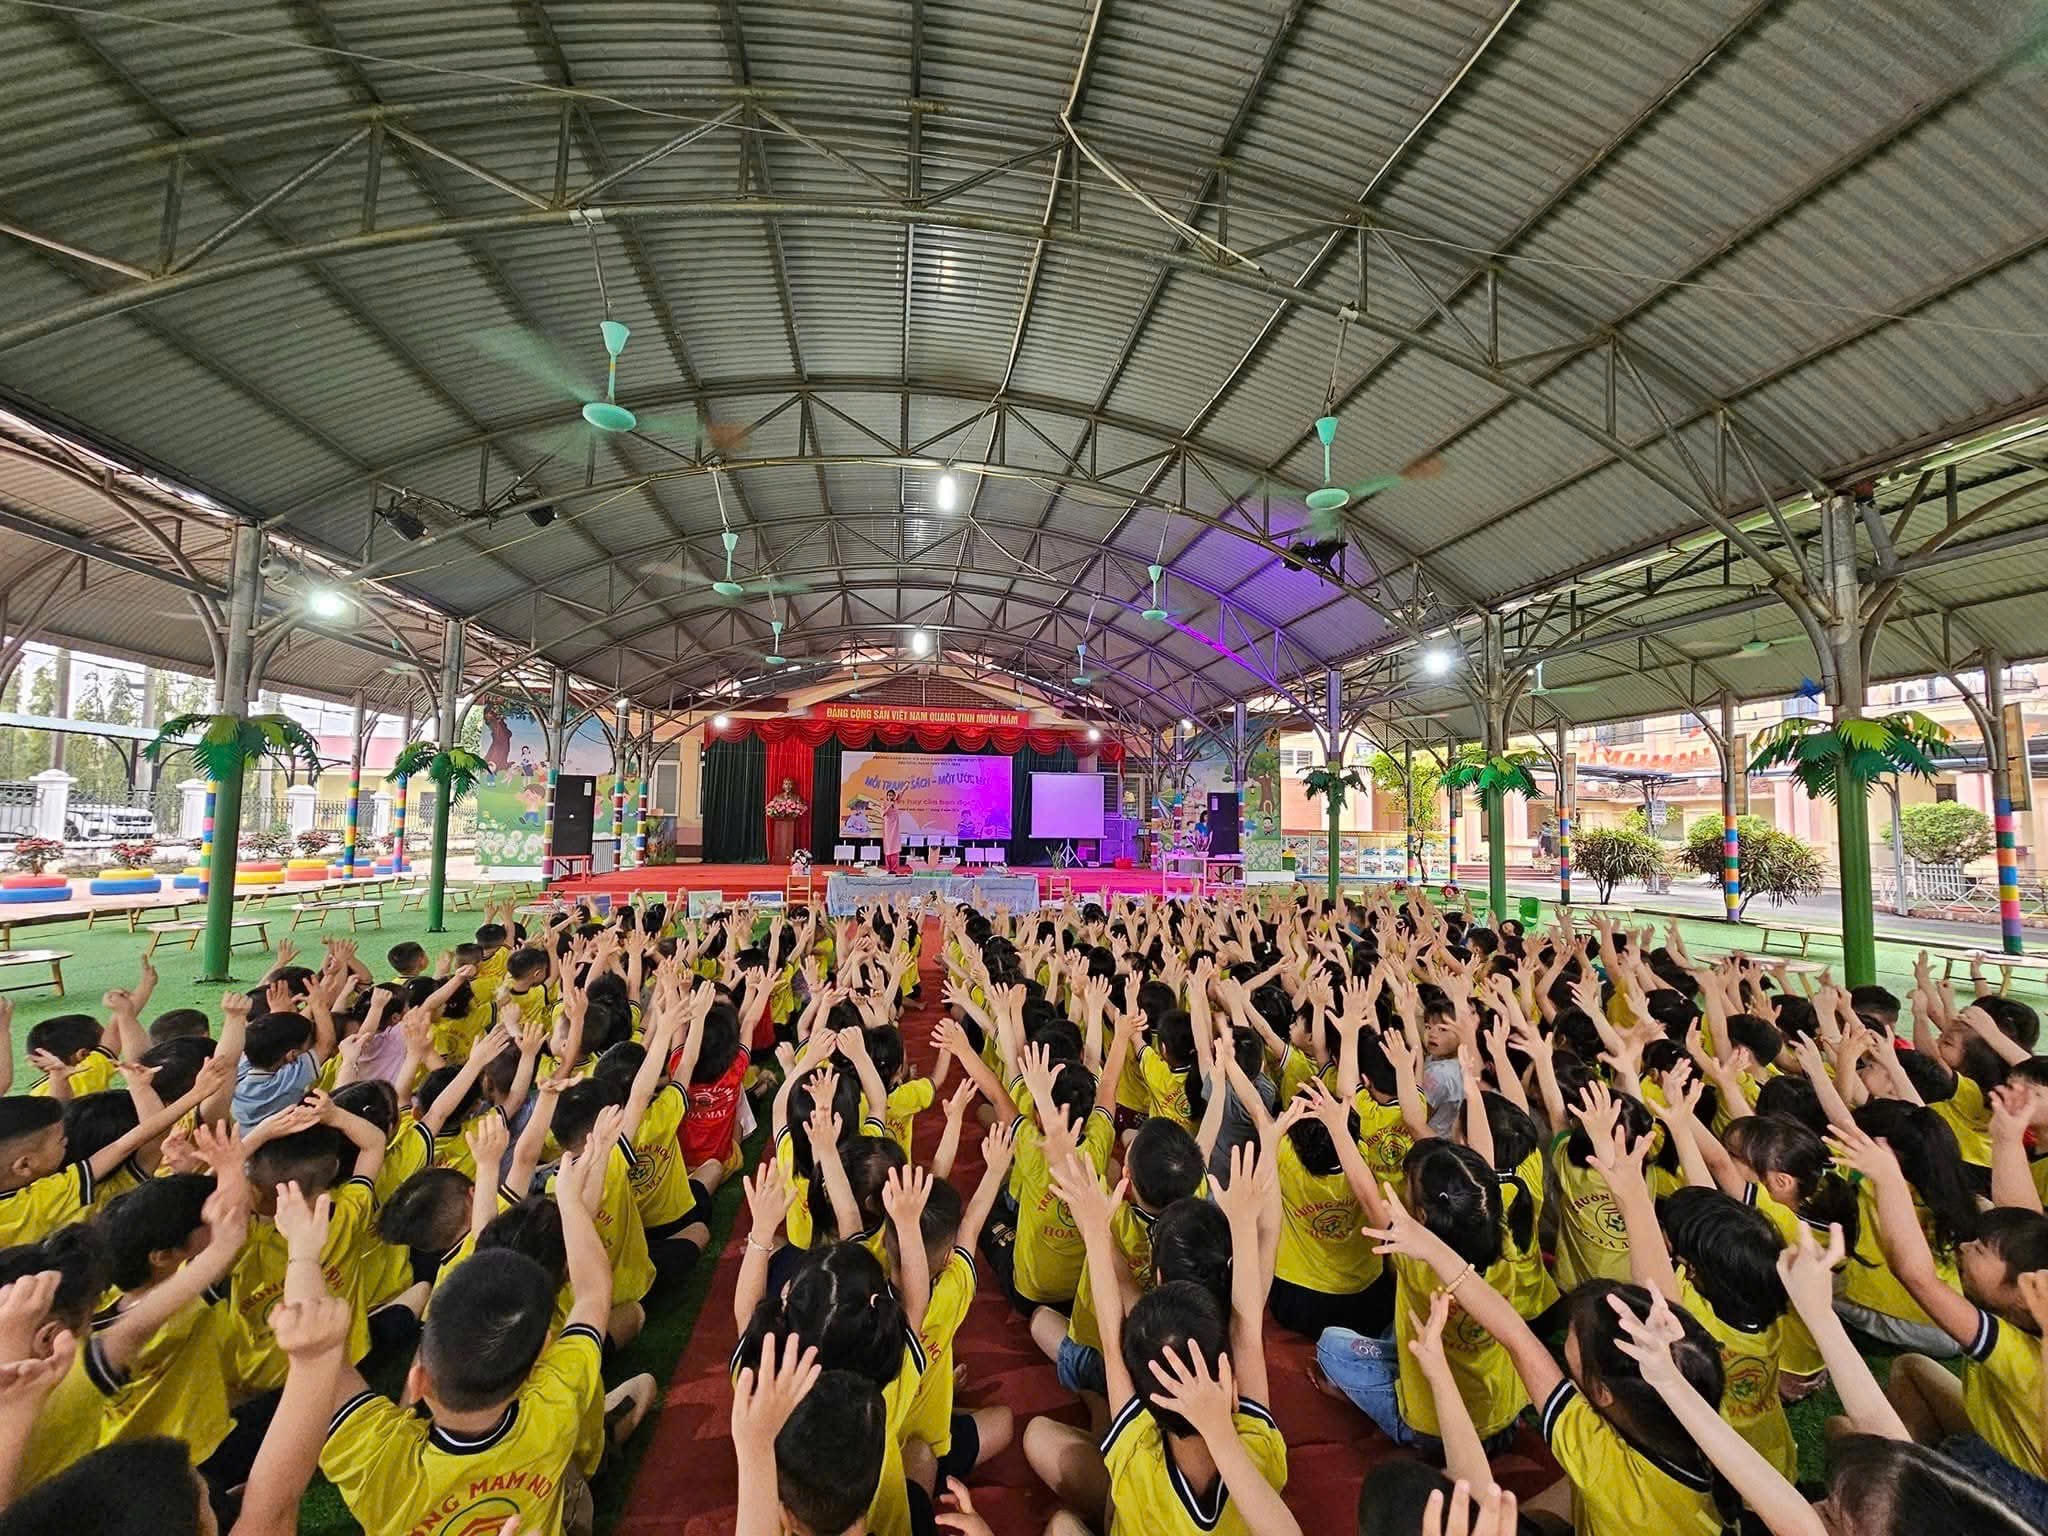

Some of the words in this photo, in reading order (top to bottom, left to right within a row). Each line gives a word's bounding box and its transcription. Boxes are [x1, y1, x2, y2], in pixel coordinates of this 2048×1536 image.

[826, 705, 848, 718] ĐẢNG
[850, 708, 872, 720] CỘNG
[873, 706, 890, 720] SẢN
[891, 709, 908, 721] VIỆT
[909, 711, 928, 721] NAM
[929, 711, 956, 722] QUANG
[957, 712, 975, 723] VINH
[976, 712, 999, 724] MUÔN
